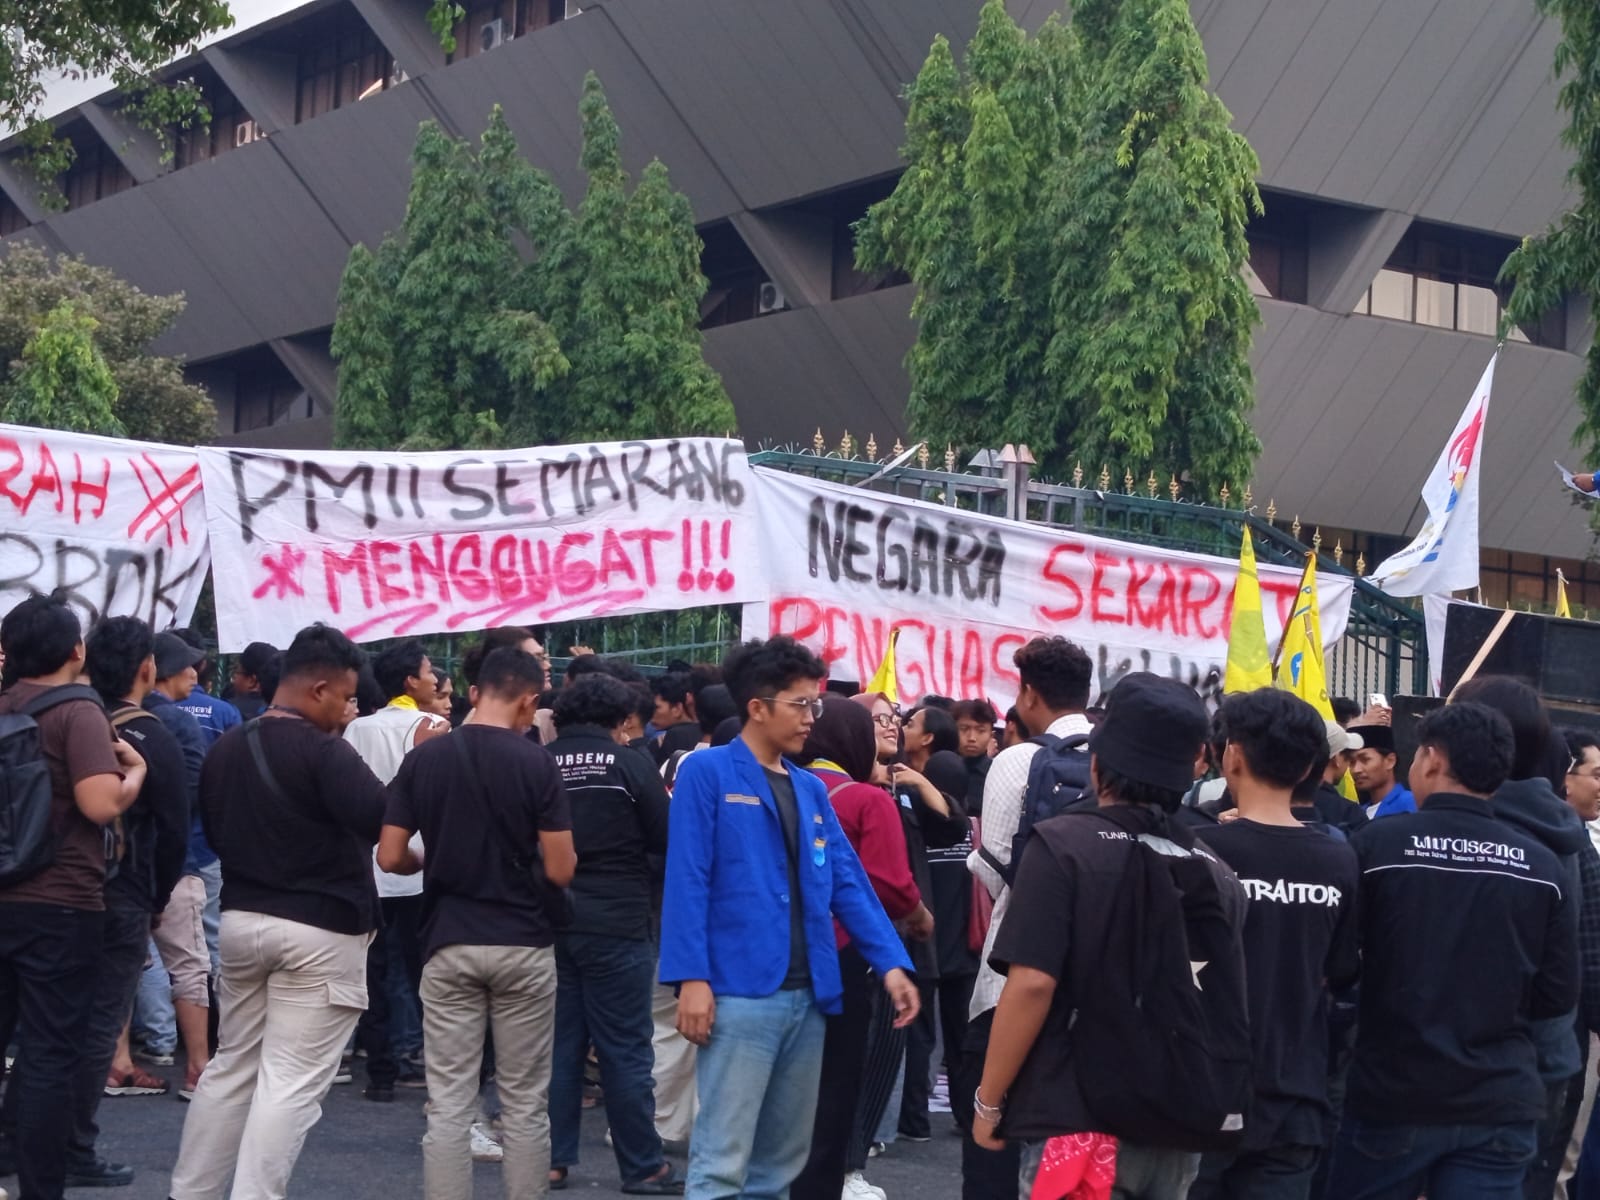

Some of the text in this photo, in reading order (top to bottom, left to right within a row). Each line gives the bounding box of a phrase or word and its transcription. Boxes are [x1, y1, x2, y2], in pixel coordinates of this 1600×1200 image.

[229, 440, 746, 544] PMII SEMARANG
[807, 495, 1006, 604] NEGARA
[770, 596, 1028, 719] PENGUAS
